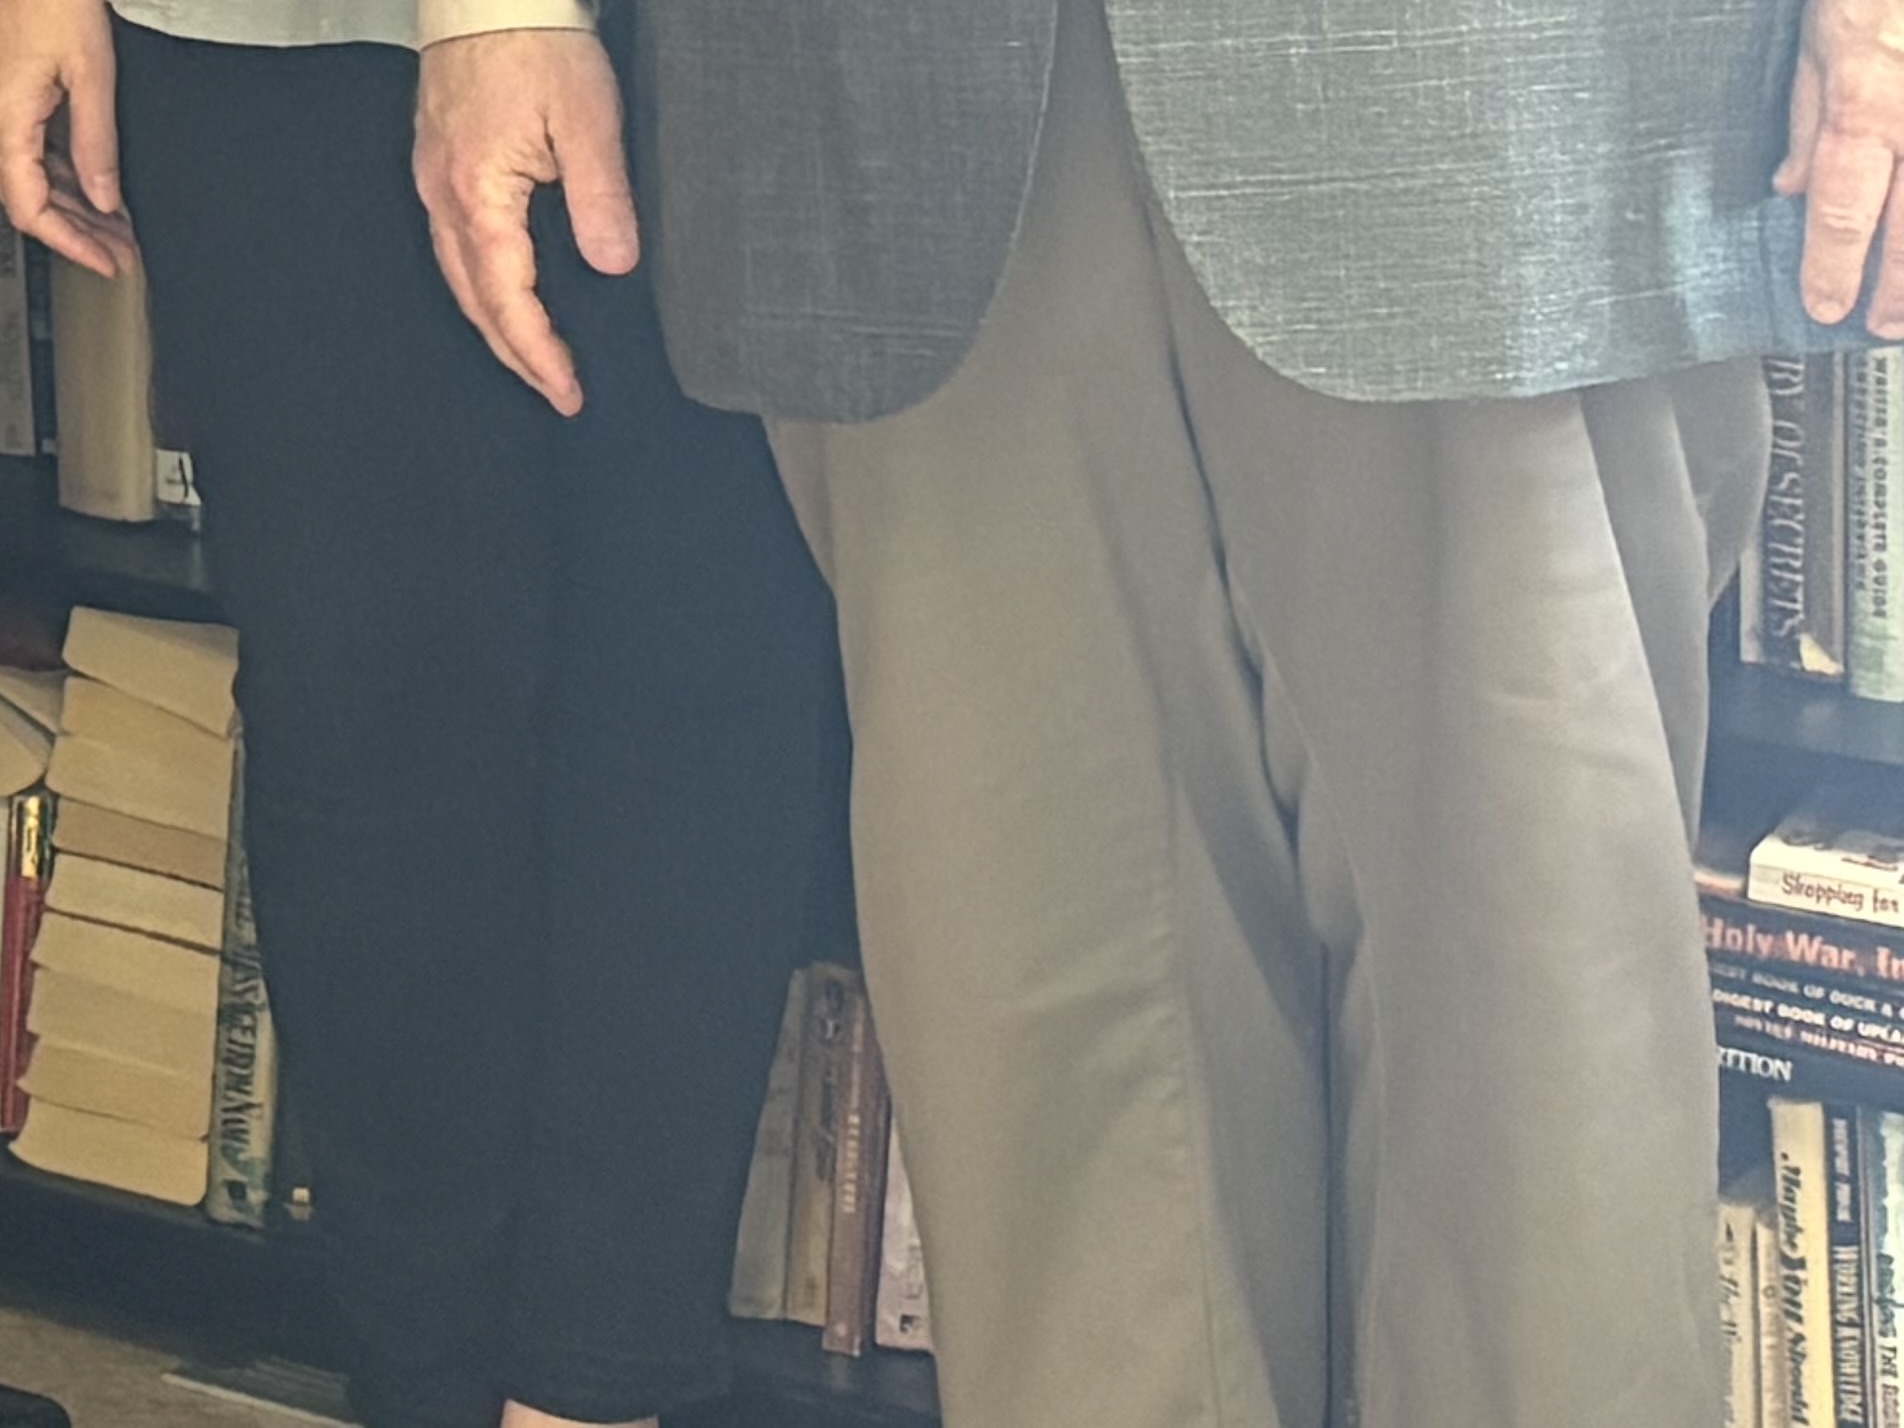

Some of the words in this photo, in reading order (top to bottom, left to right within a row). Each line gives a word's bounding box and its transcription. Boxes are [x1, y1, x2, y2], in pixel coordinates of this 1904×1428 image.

[1872, 451, 1889, 554] COMPLETE
[1768, 470, 1805, 640] SECRETS
[1873, 558, 1890, 620] GUIDE
[1781, 872, 1865, 913] Shopping
[1871, 894, 1899, 916] for
[1701, 912, 1776, 958] Holy
[1784, 929, 1865, 977] War,
[1712, 989, 1773, 1014] DIGEST
[1777, 1003, 1827, 1026] BOOK
[1830, 1016, 1855, 1032] OF
[1779, 1151, 1804, 1250] Maybe
[1779, 1250, 1809, 1325] You
[1831, 1244, 1861, 1324] WORKING
[1787, 1327, 1811, 1427] Should
[1834, 1324, 1863, 1425] KNOWLEDGE
